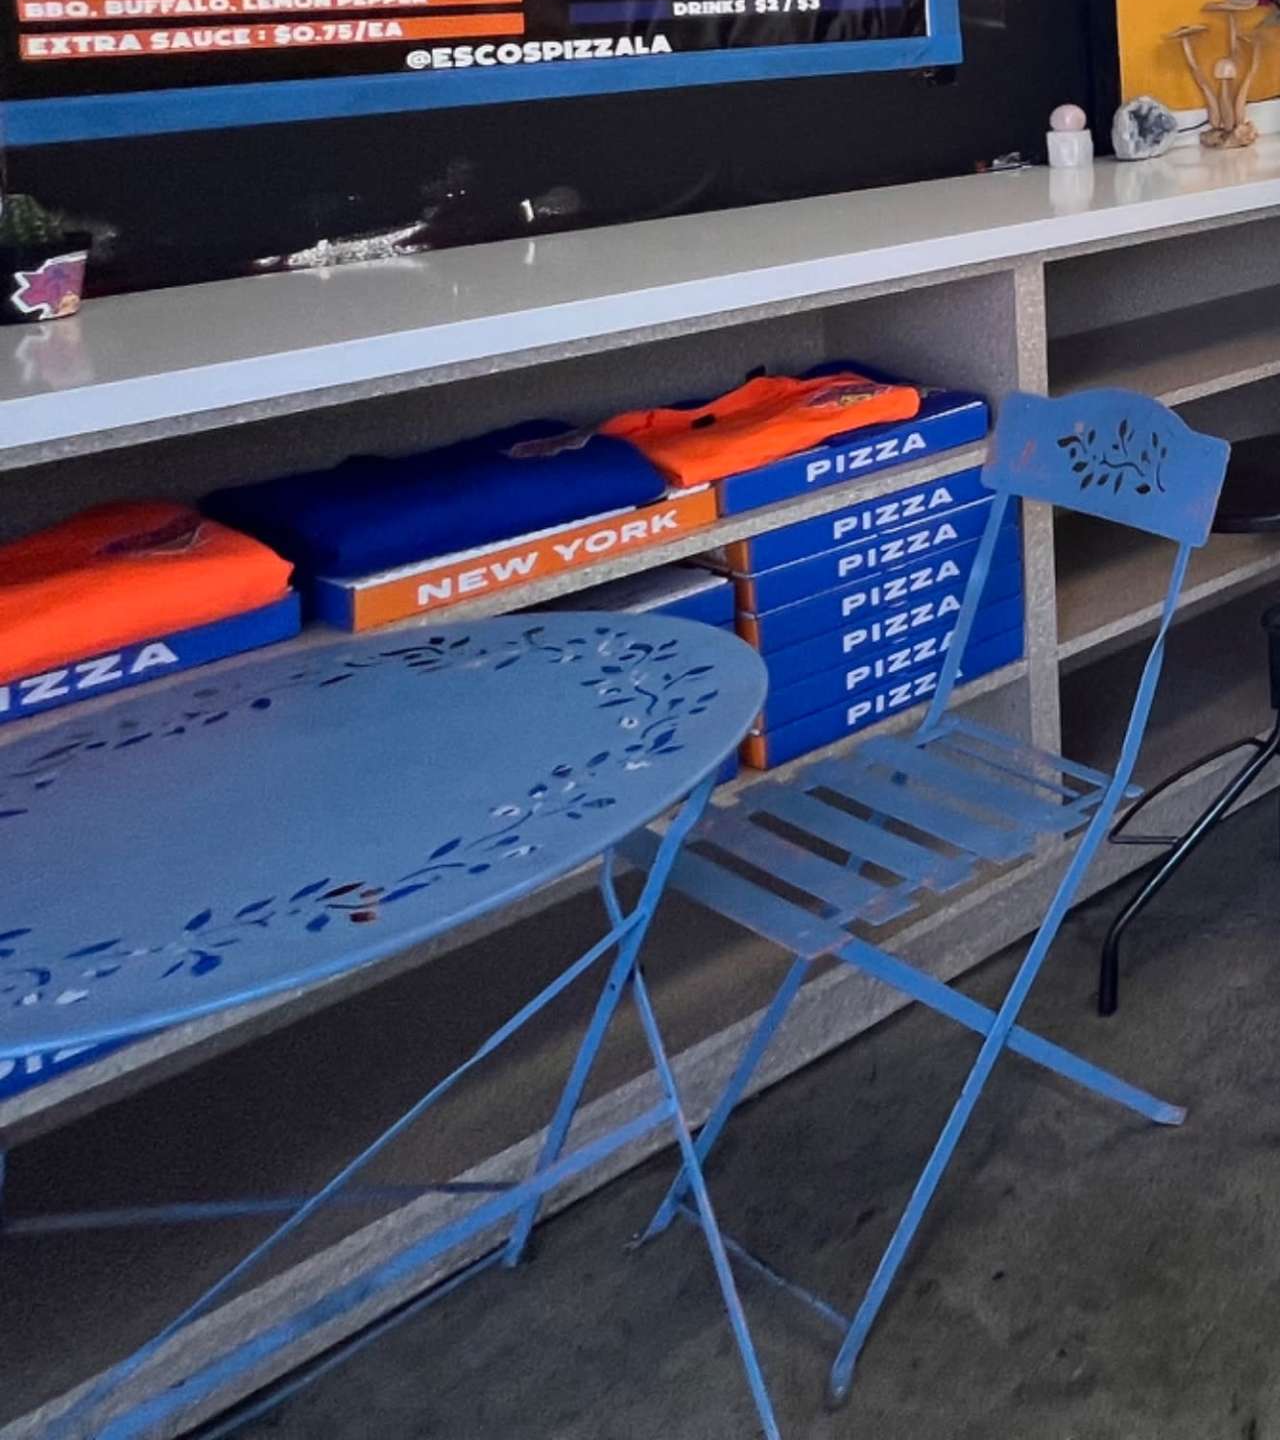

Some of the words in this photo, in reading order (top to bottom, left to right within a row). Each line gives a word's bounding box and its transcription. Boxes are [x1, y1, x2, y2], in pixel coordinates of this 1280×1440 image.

[27, 34, 143, 56] EXTRA
[151, 29, 251, 52] SAUCE
[275, 21, 403, 45] $0.75/EA
[407, 34, 673, 71] @ESCOSPIZZALA
[806, 431, 927, 482] PIZZA
[833, 487, 953, 540] PIZZA
[417, 552, 538, 605] NEW
[553, 509, 679, 561] YORK
[838, 523, 958, 577] PIZZA
[842, 560, 960, 616] PIZZA
[843, 594, 961, 653] PIZZA
[0, 642, 178, 712] IZZA
[846, 669, 962, 726] PIZZ
